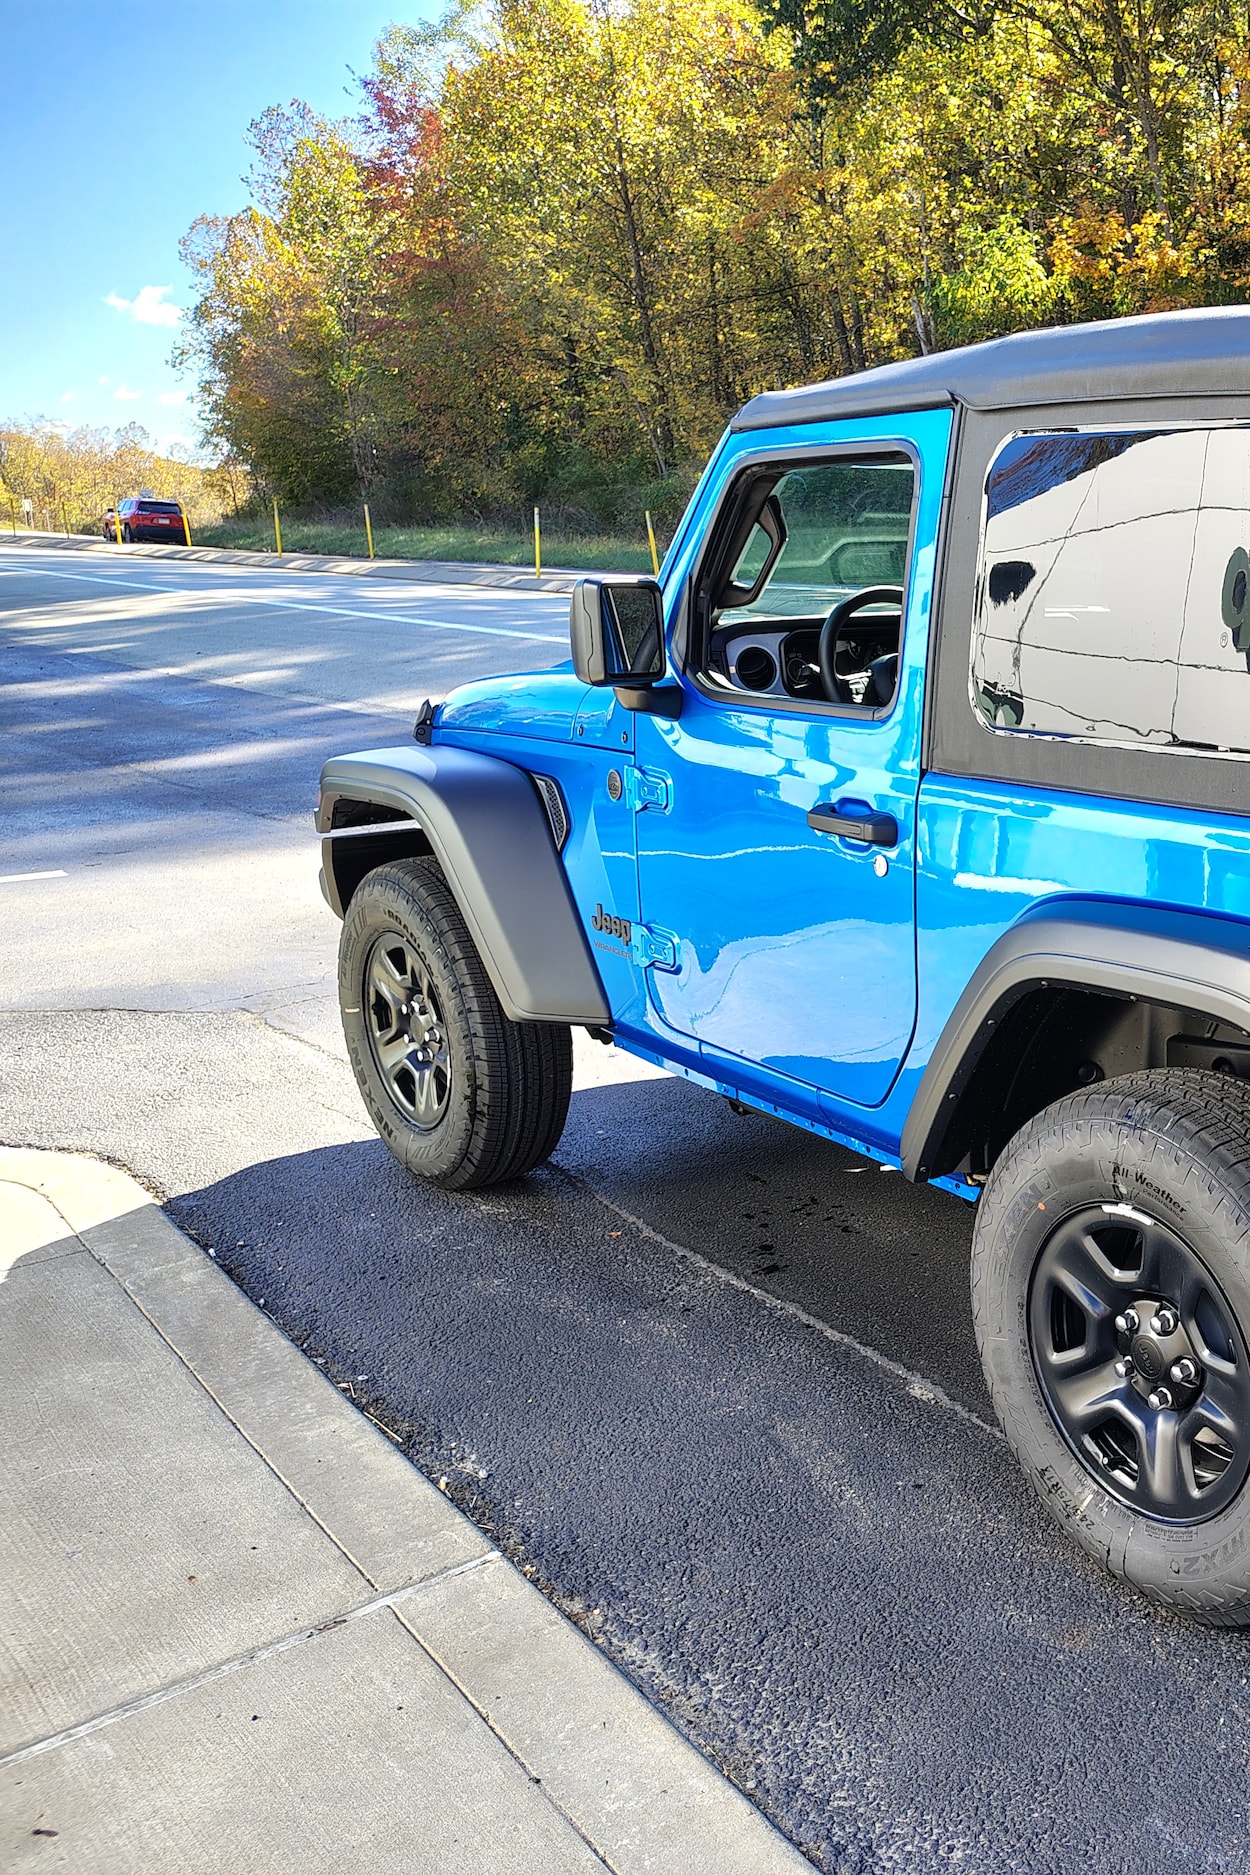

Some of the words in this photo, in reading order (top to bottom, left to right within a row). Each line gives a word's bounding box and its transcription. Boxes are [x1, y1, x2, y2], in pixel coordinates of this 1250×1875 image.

[591, 903, 631, 946] Jeep
[351, 1046, 395, 1139] NEXEN
[1112, 1165, 1188, 1215] All-Weather
[1142, 1188, 1185, 1222] Performance
